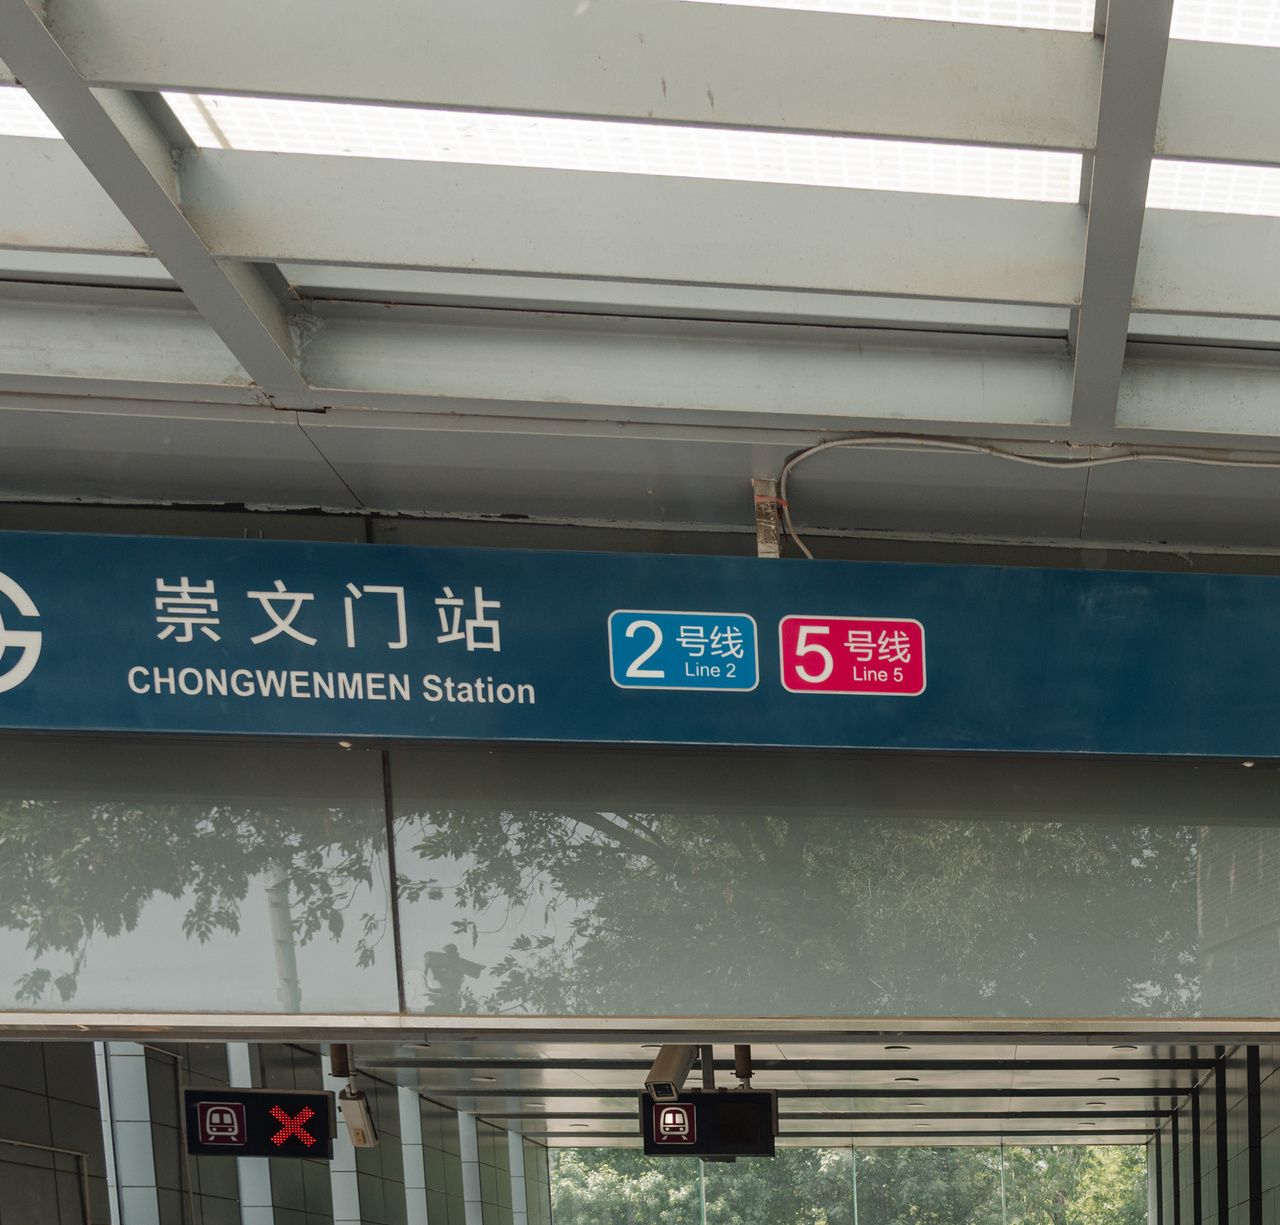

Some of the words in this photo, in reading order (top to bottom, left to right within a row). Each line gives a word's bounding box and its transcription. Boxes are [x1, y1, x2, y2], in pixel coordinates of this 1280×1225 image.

[155, 576, 501, 652] 崇文门站
[685, 662, 720, 677] Line
[726, 663, 736, 678] 2
[853, 666, 888, 682] Line
[893, 667, 903, 682] 5
[127, 665, 411, 701] CHONGWENMEN
[422, 674, 536, 704] Station
